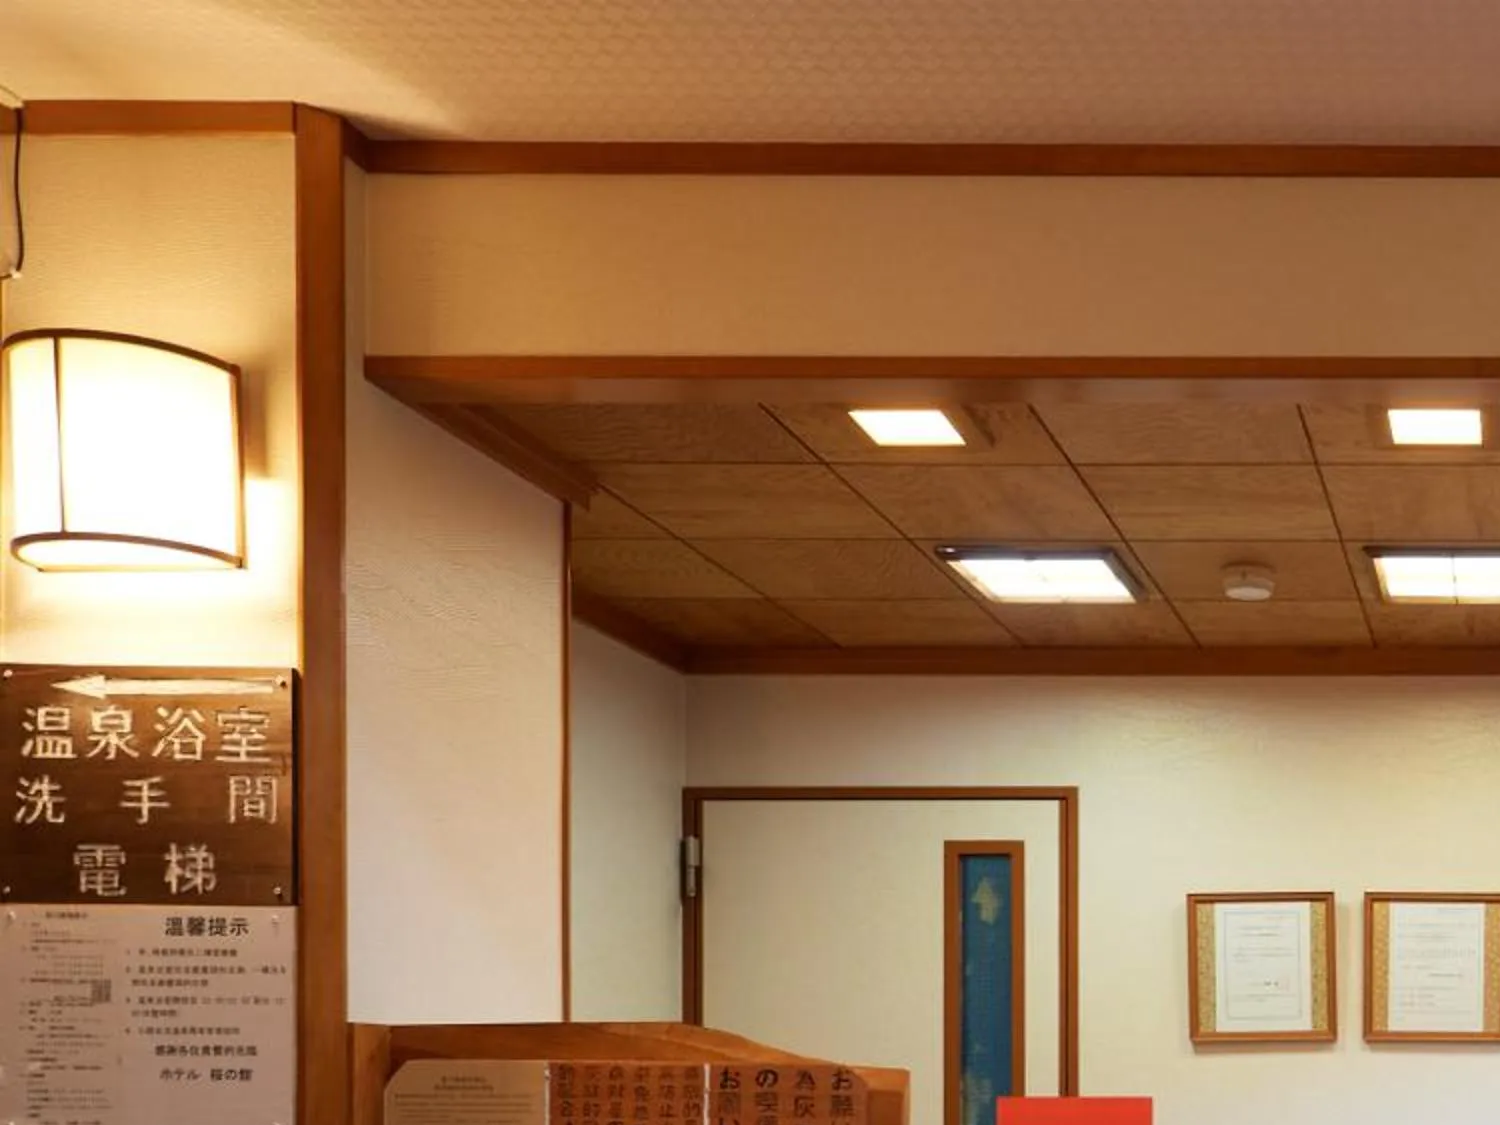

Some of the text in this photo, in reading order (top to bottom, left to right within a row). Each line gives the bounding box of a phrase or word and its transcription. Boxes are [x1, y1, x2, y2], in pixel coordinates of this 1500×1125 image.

[20, 705, 272, 763] 温泉浴室
[73, 843, 218, 897] 電梯
